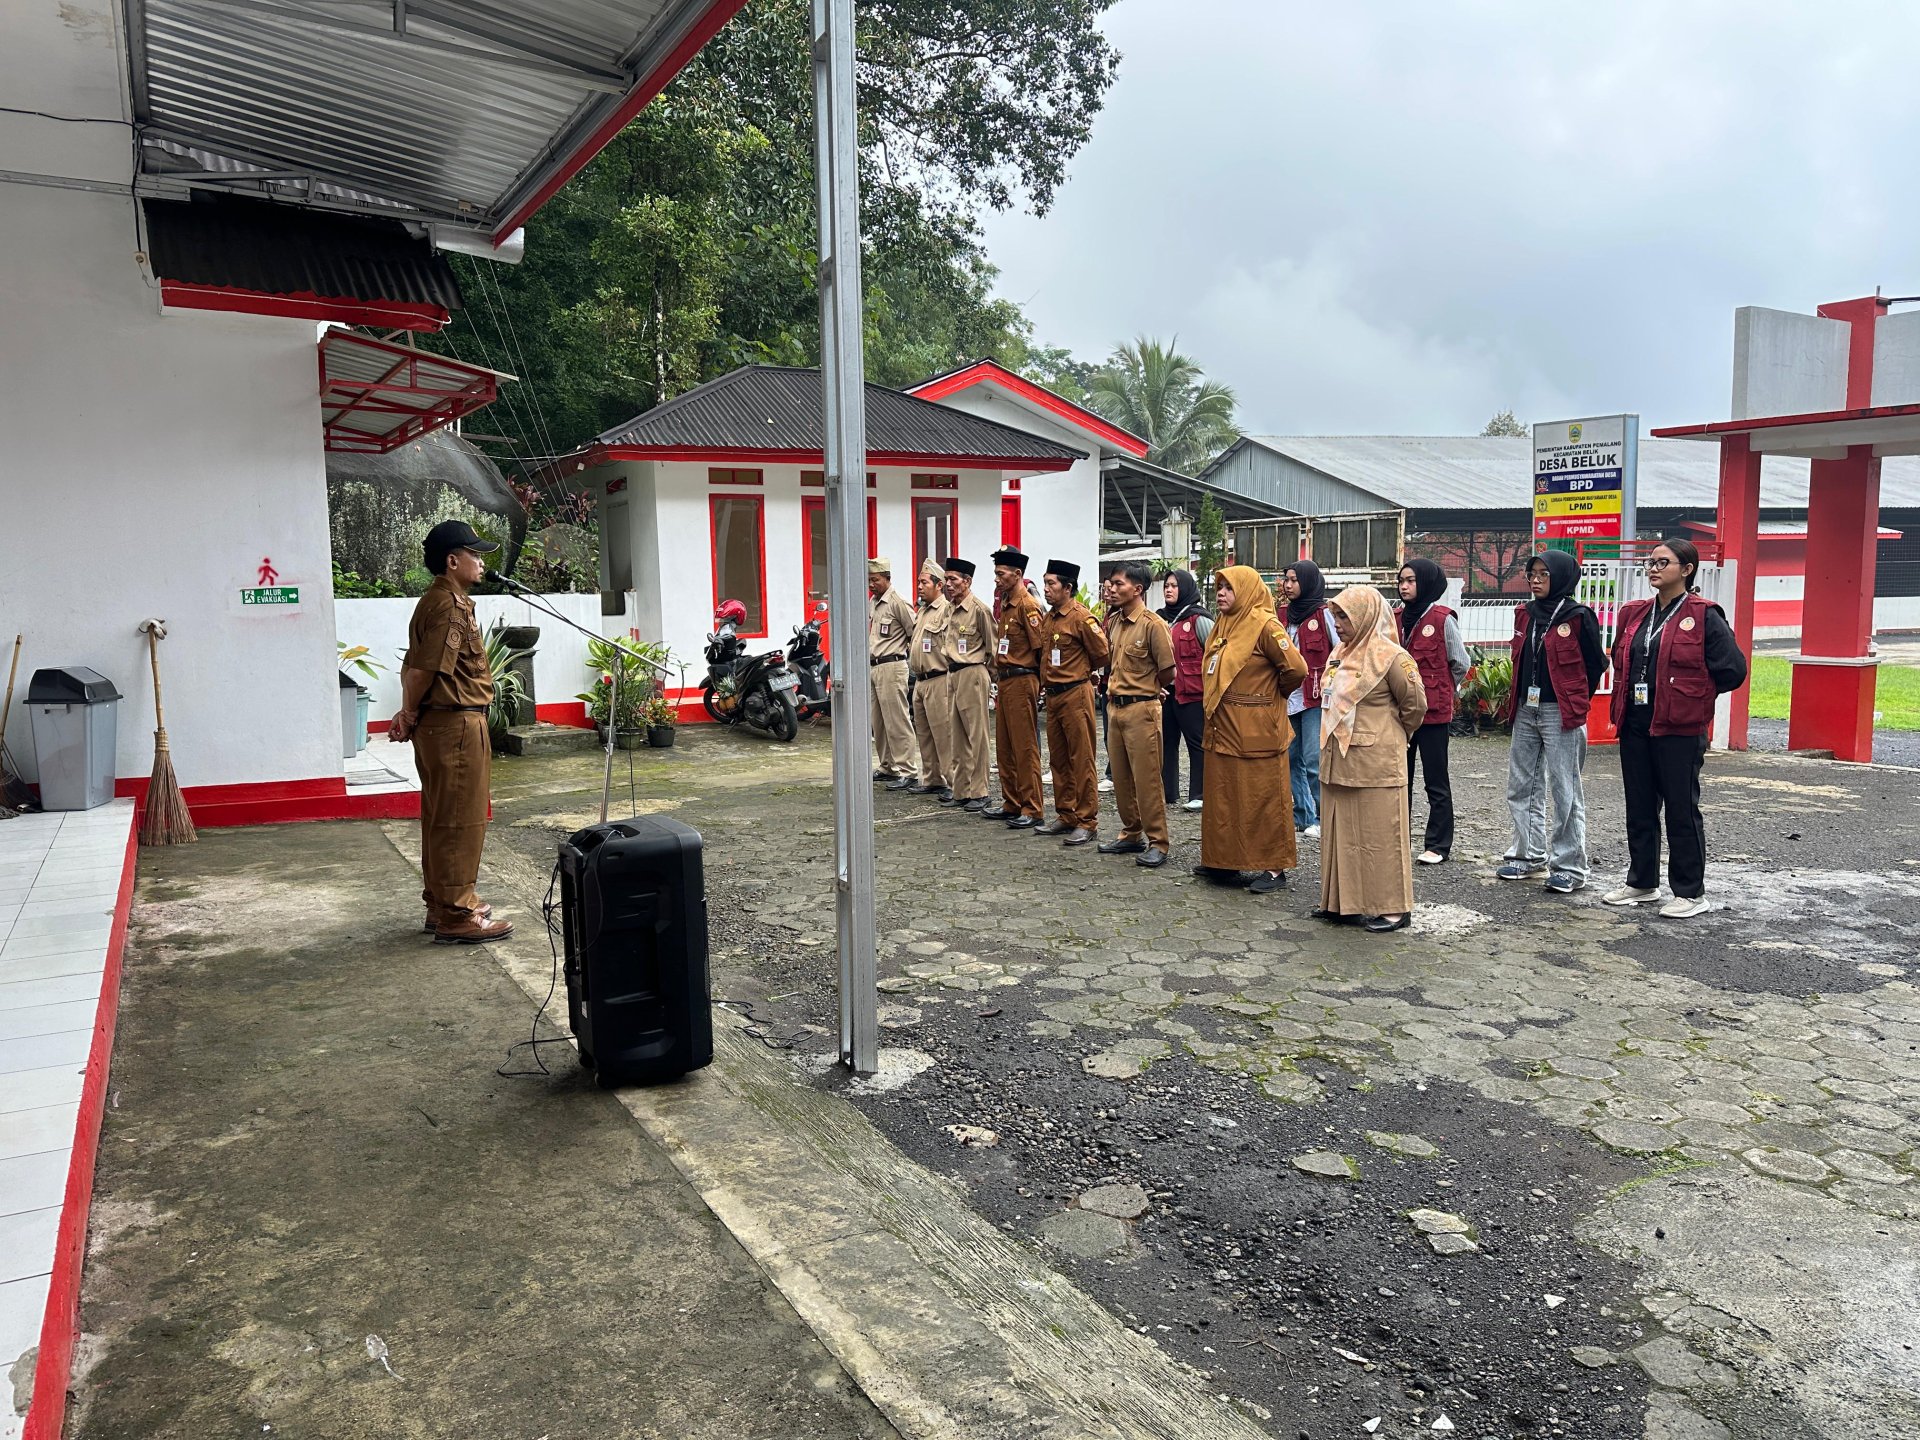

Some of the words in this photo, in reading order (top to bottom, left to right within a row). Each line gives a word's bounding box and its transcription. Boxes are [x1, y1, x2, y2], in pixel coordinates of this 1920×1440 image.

[1563, 443, 1591, 451] KABUPATEN
[1539, 457, 1568, 471] DESA
[1571, 453, 1617, 468] BELUK
[1569, 479, 1594, 490] BPD
[1569, 502, 1593, 511] LPMD
[1566, 526, 1595, 534] KPMD
[256, 595, 288, 603] EVAKUASI
